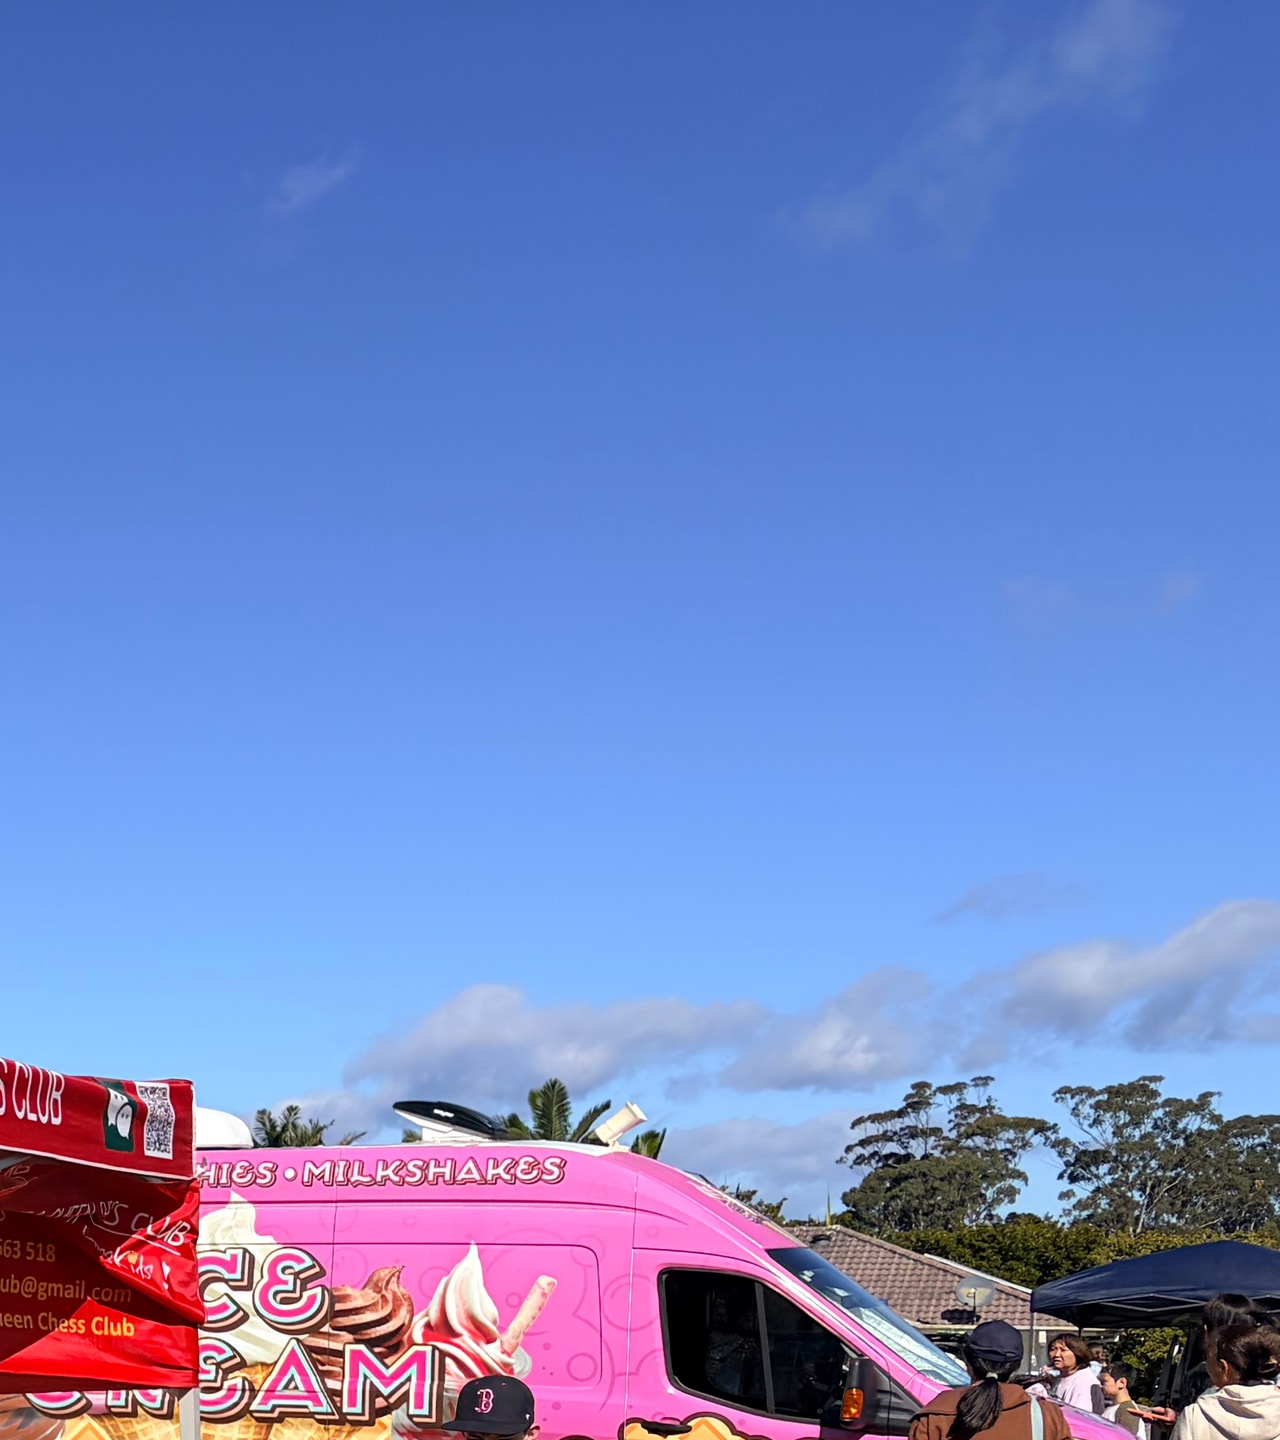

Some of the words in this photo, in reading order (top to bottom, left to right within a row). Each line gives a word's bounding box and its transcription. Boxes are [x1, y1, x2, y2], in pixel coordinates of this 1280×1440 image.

[11, 1061, 65, 1126] CLUB
[301, 1155, 568, 1188] MILKSHAKES
[26, 1242, 57, 1263] 518
[197, 1246, 334, 1335] CE
[37, 1311, 86, 1335] Chess
[90, 1316, 135, 1338] Club
[474, 1388, 495, 1414] B
